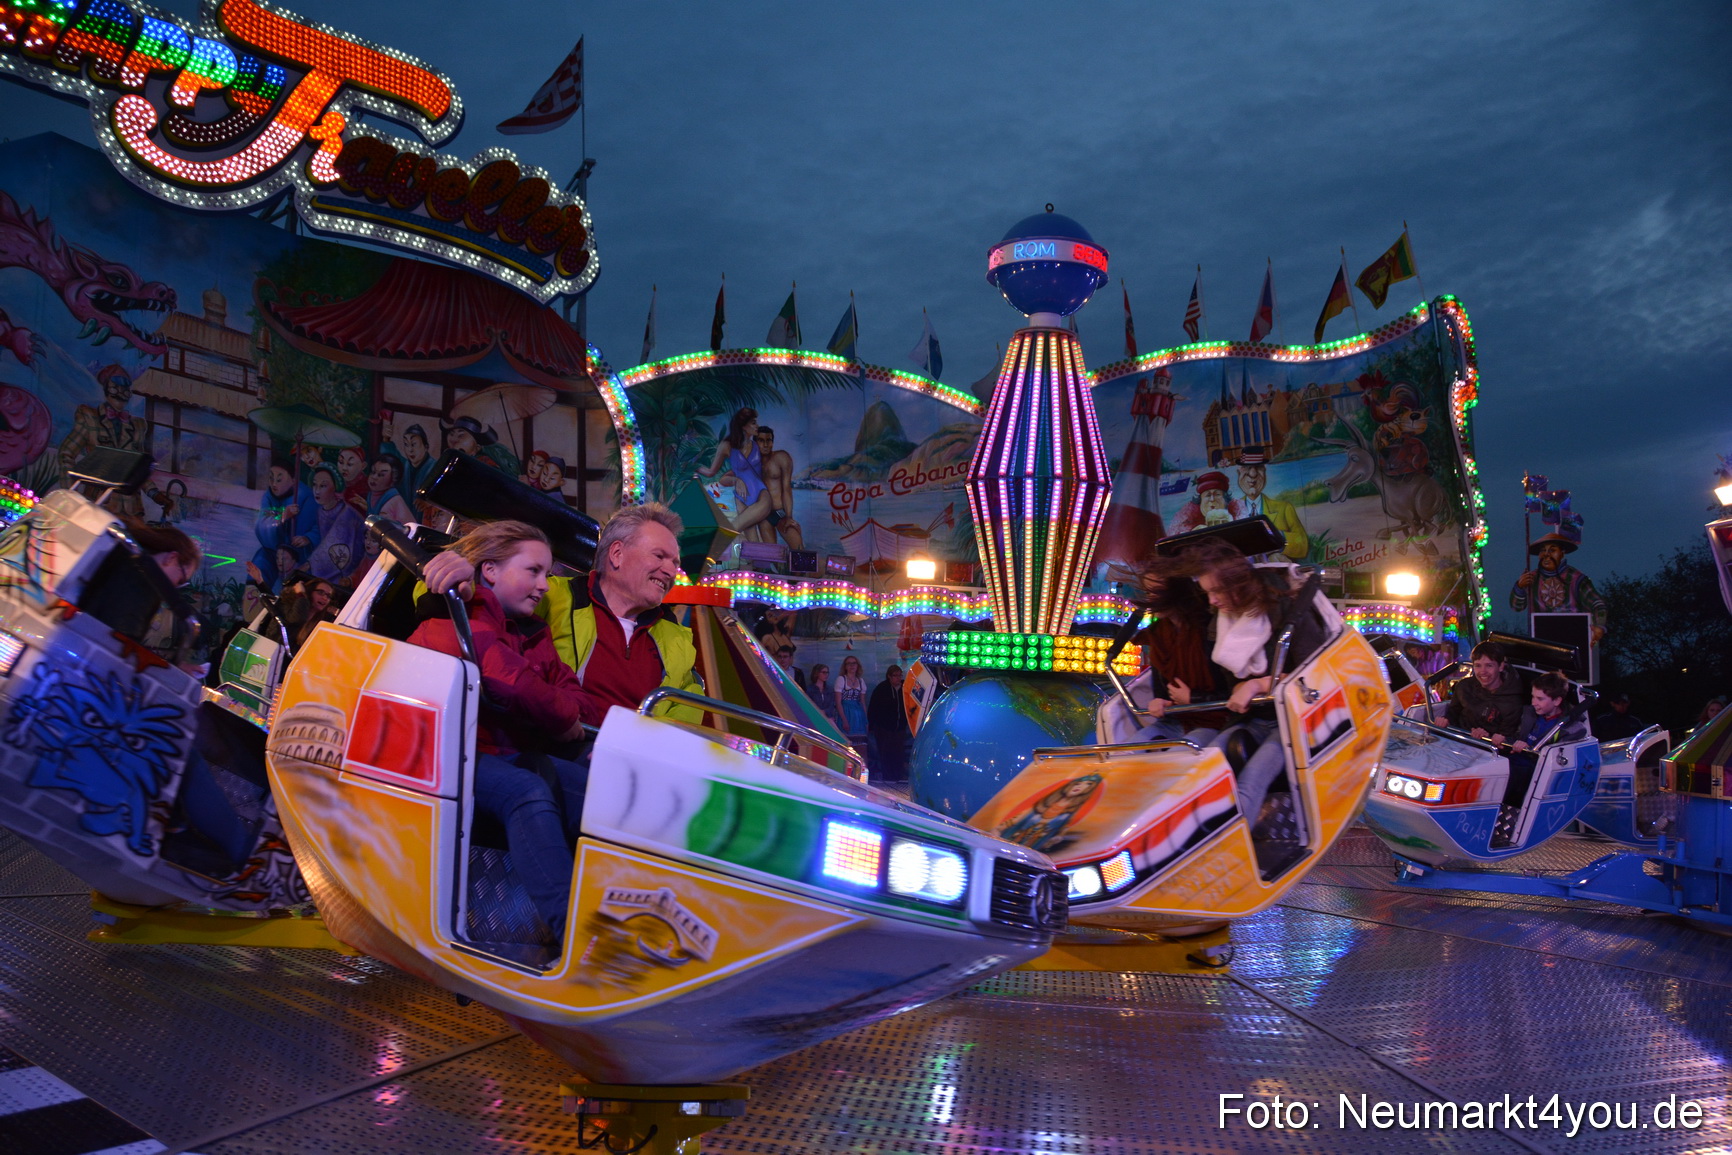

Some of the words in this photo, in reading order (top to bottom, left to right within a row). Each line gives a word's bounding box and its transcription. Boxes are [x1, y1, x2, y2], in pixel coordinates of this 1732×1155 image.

[1013, 241, 1056, 260] ROM
[827, 482, 884, 514] Copa
[888, 461, 971, 496] Cabana
